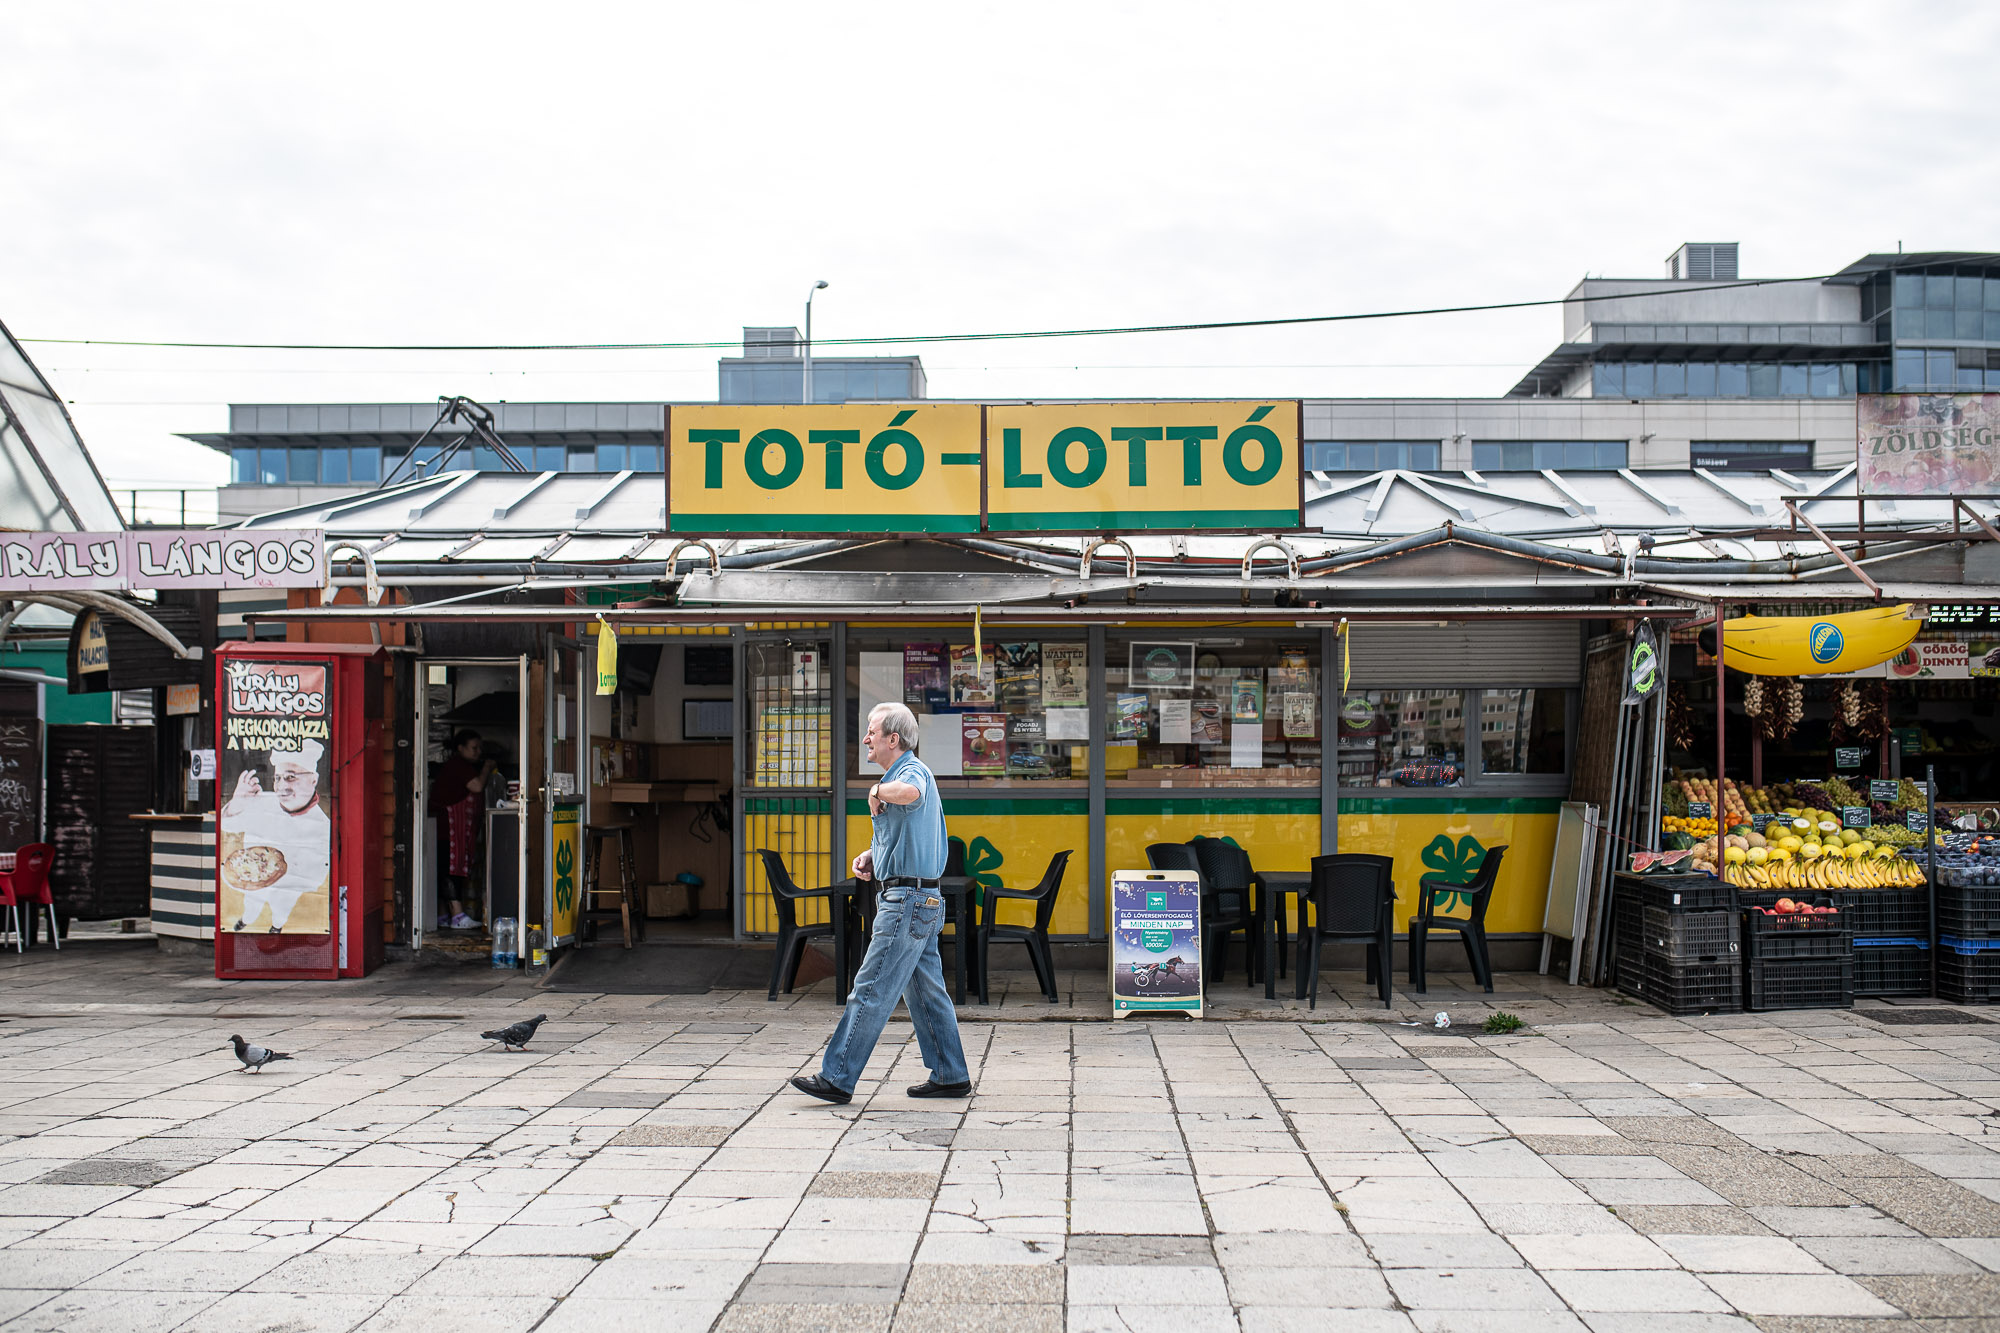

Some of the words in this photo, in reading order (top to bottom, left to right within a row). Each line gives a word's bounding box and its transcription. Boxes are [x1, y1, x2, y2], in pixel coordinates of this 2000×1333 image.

[137, 536, 315, 580] LÁNGOS
[1044, 651, 1084, 659] WANTED
[231, 669, 300, 692] KIRÁLY
[232, 686, 324, 716] LÁNGOS
[227, 714, 329, 740] MEGKORONÁZZA
[227, 735, 239, 751] A
[242, 735, 303, 752] NAPOD!
[1400, 764, 1454, 780] NYITVA
